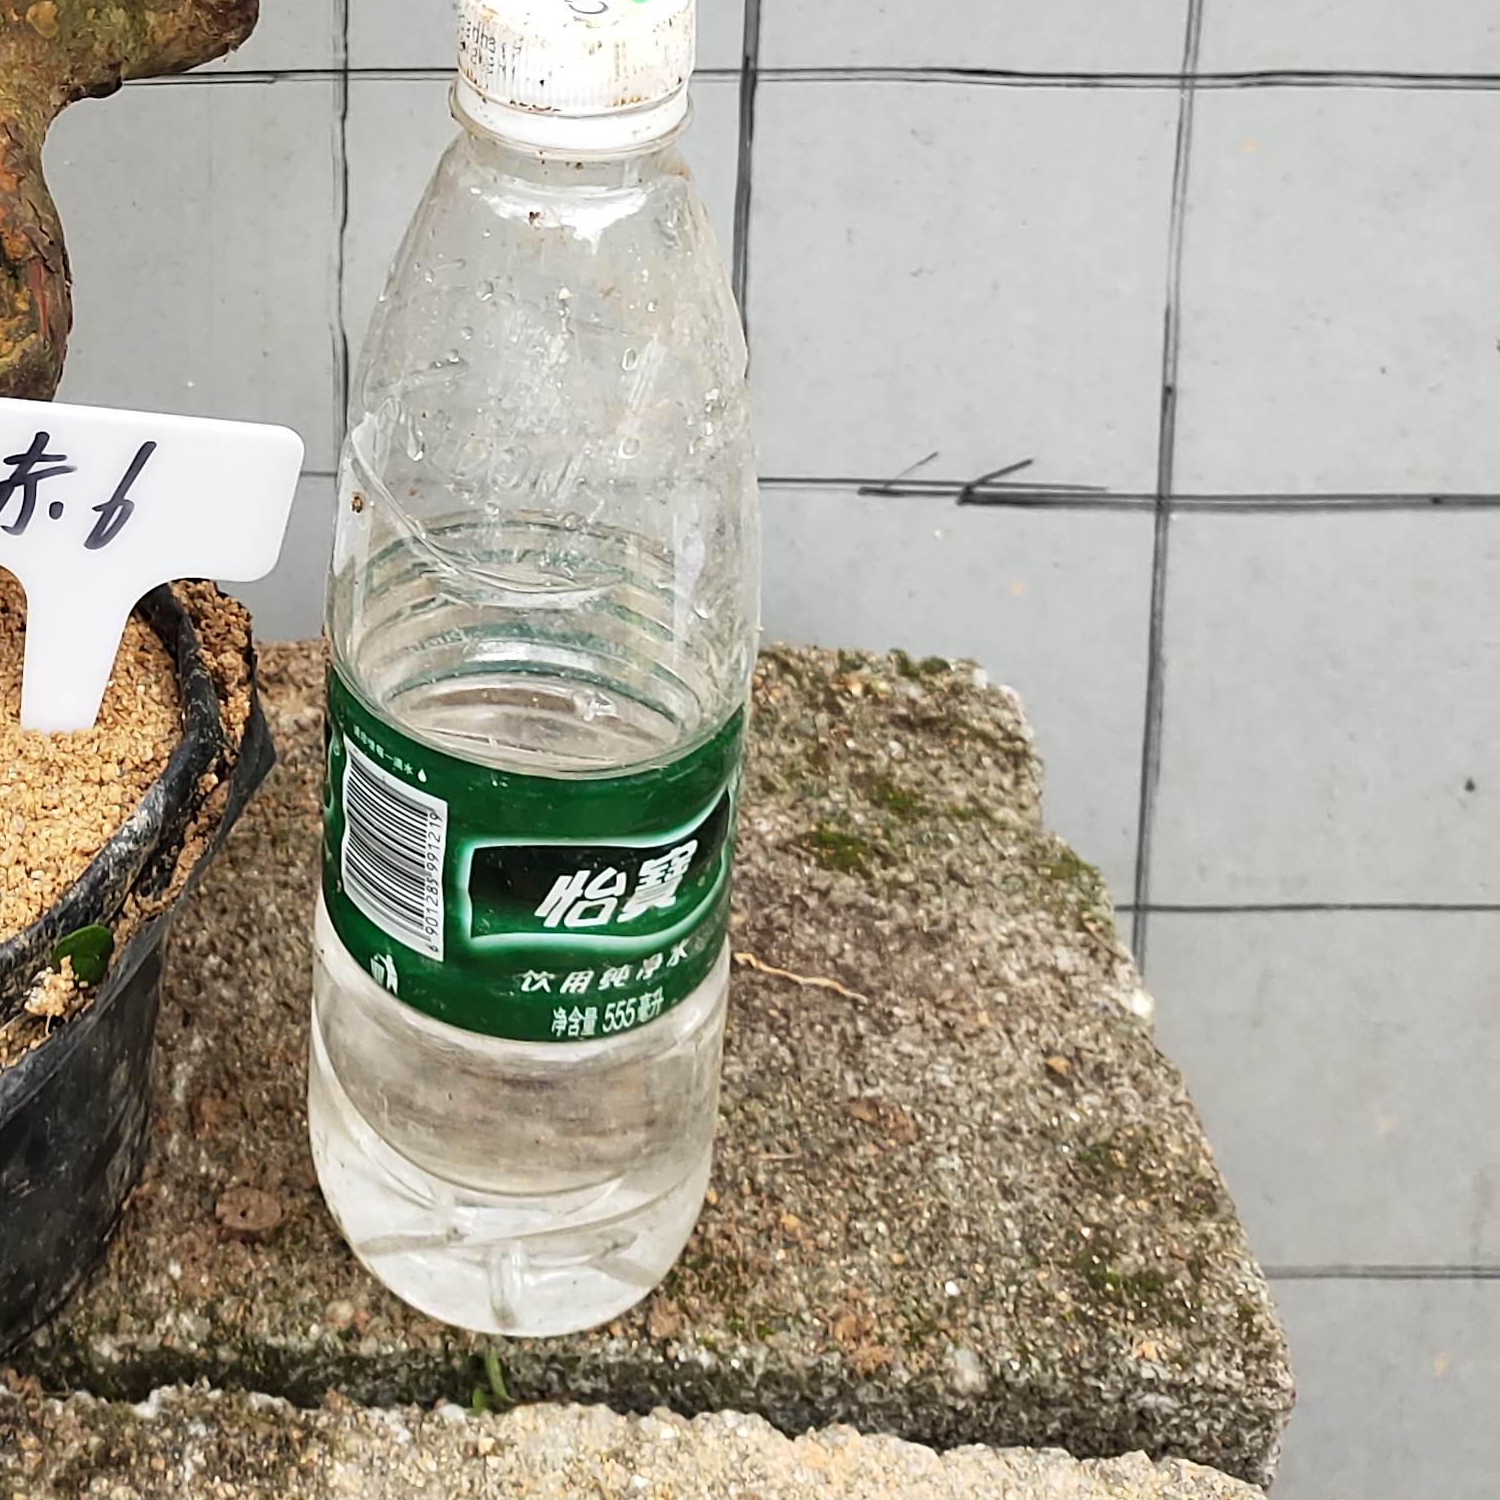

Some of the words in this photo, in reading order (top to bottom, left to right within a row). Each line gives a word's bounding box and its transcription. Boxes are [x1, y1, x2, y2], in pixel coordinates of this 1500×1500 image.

[534, 839, 698, 928] 怡寶
[519, 938, 689, 994] 饮用纯净水
